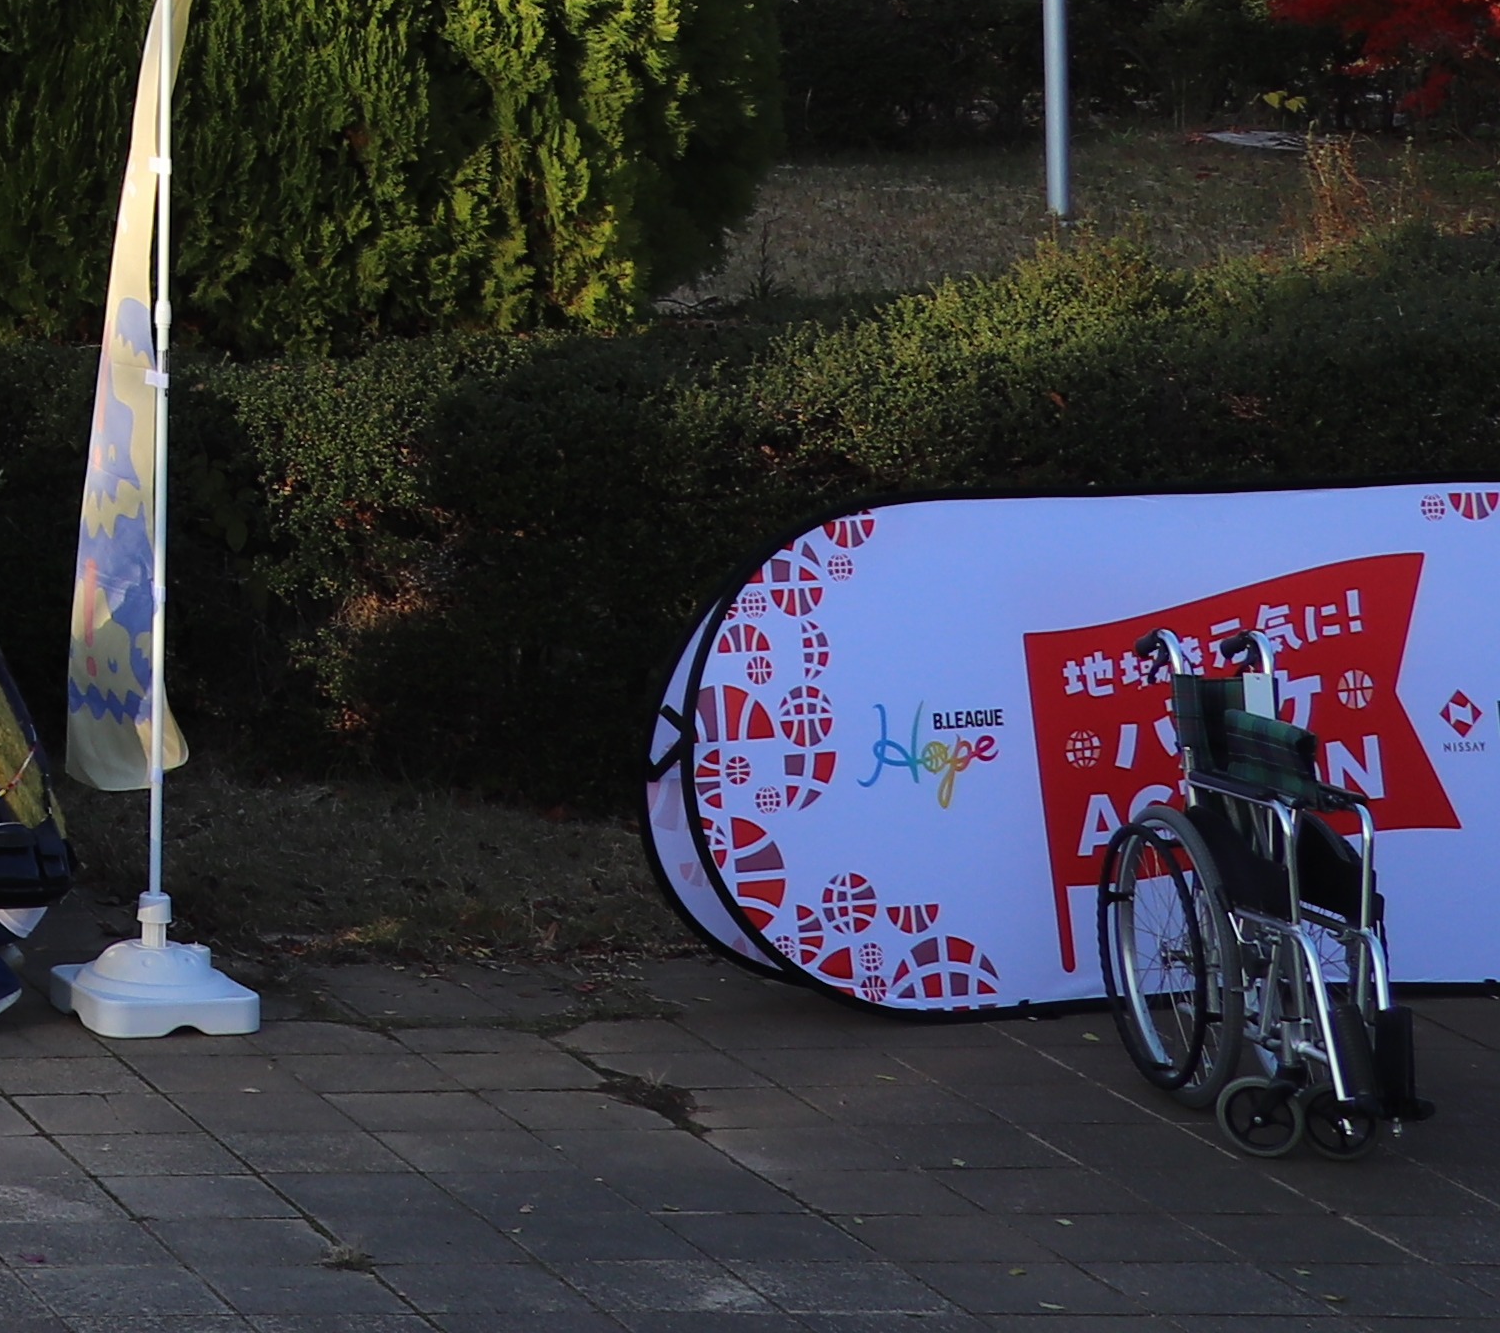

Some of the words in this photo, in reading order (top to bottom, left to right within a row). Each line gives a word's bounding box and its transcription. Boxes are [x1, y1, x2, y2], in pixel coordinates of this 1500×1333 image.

[932, 708, 1005, 730] B.LEAGUE
[1115, 670, 1322, 769] バケ
[1443, 741, 1486, 753] NISSAY
[857, 700, 999, 809] Hope
